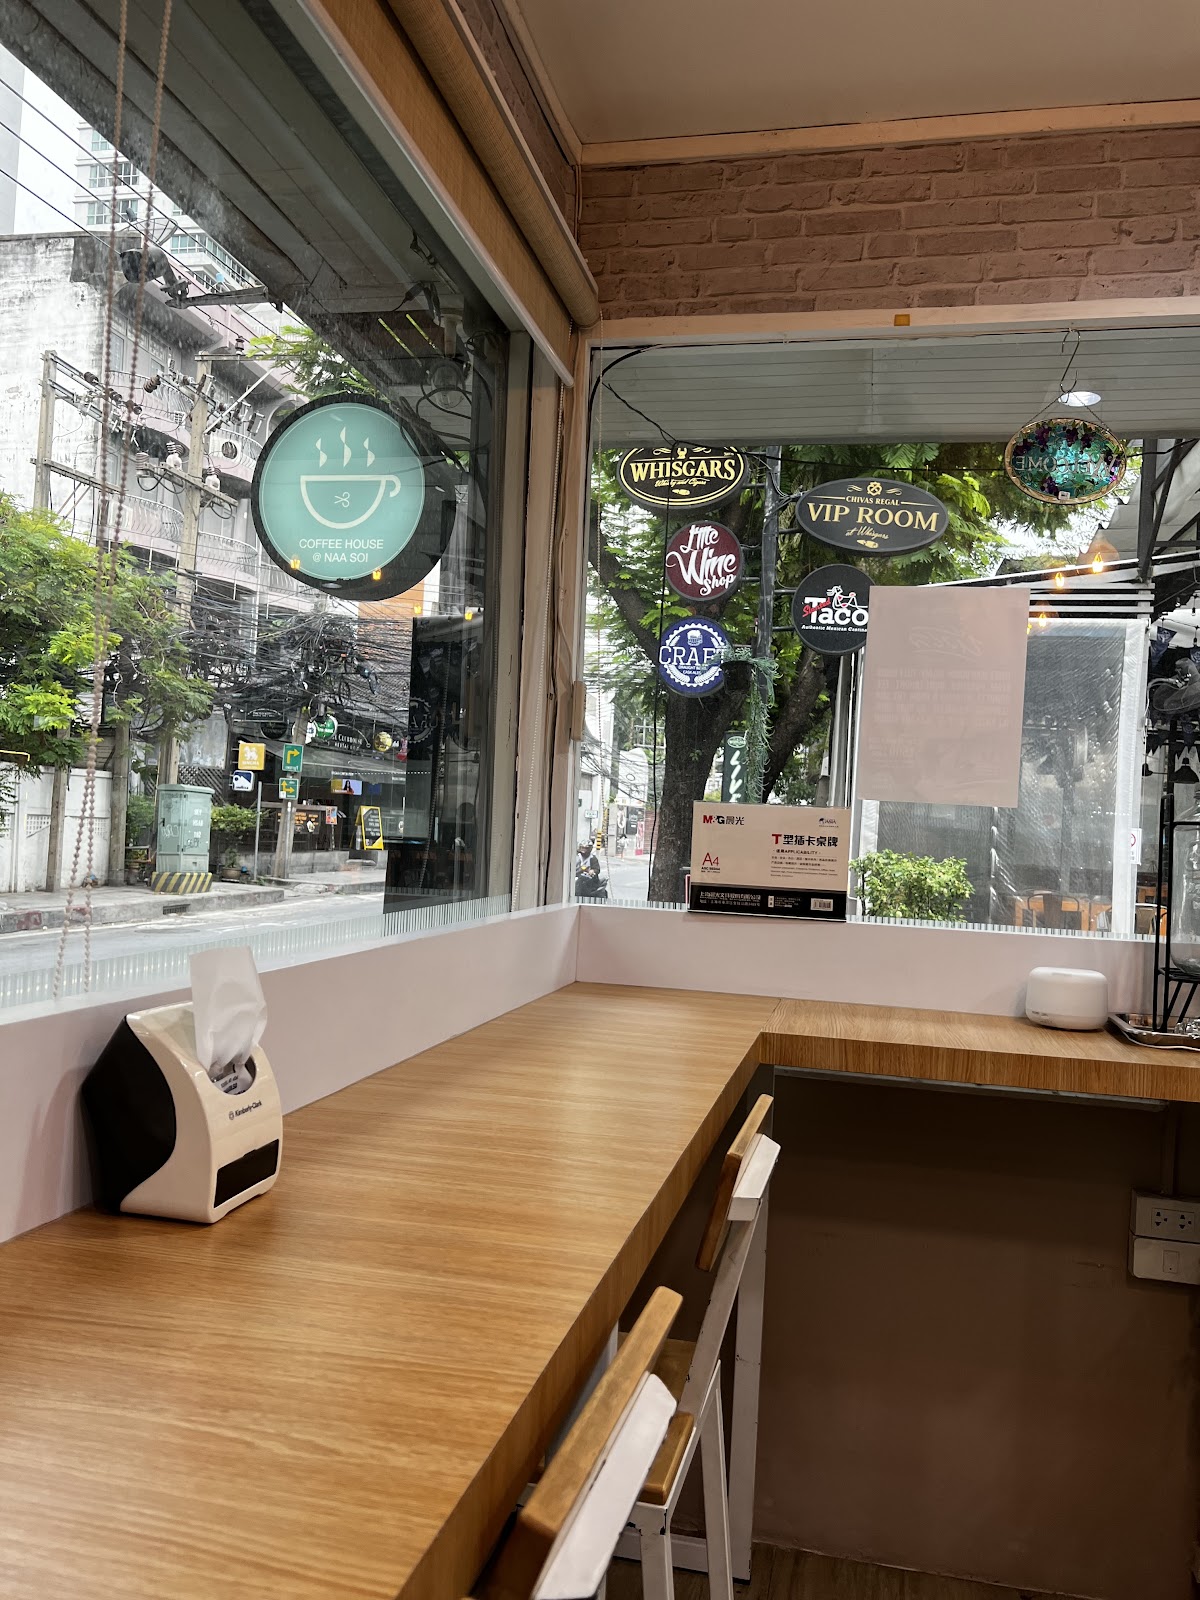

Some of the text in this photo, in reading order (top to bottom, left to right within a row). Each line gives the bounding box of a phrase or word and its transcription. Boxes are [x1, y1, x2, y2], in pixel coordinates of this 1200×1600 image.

[630, 459, 736, 482] WHISGARS
[846, 495, 900, 506] CHIVAS REGAL
[807, 502, 939, 532] VIP ROOM
[299, 539, 384, 549] COFFEE HOUSE
[312, 553, 368, 563] @ NAA SOI
[665, 548, 737, 585] Wine
[700, 575, 737, 596] Shop
[804, 597, 869, 626] Taco
[702, 852, 720, 866] A4
